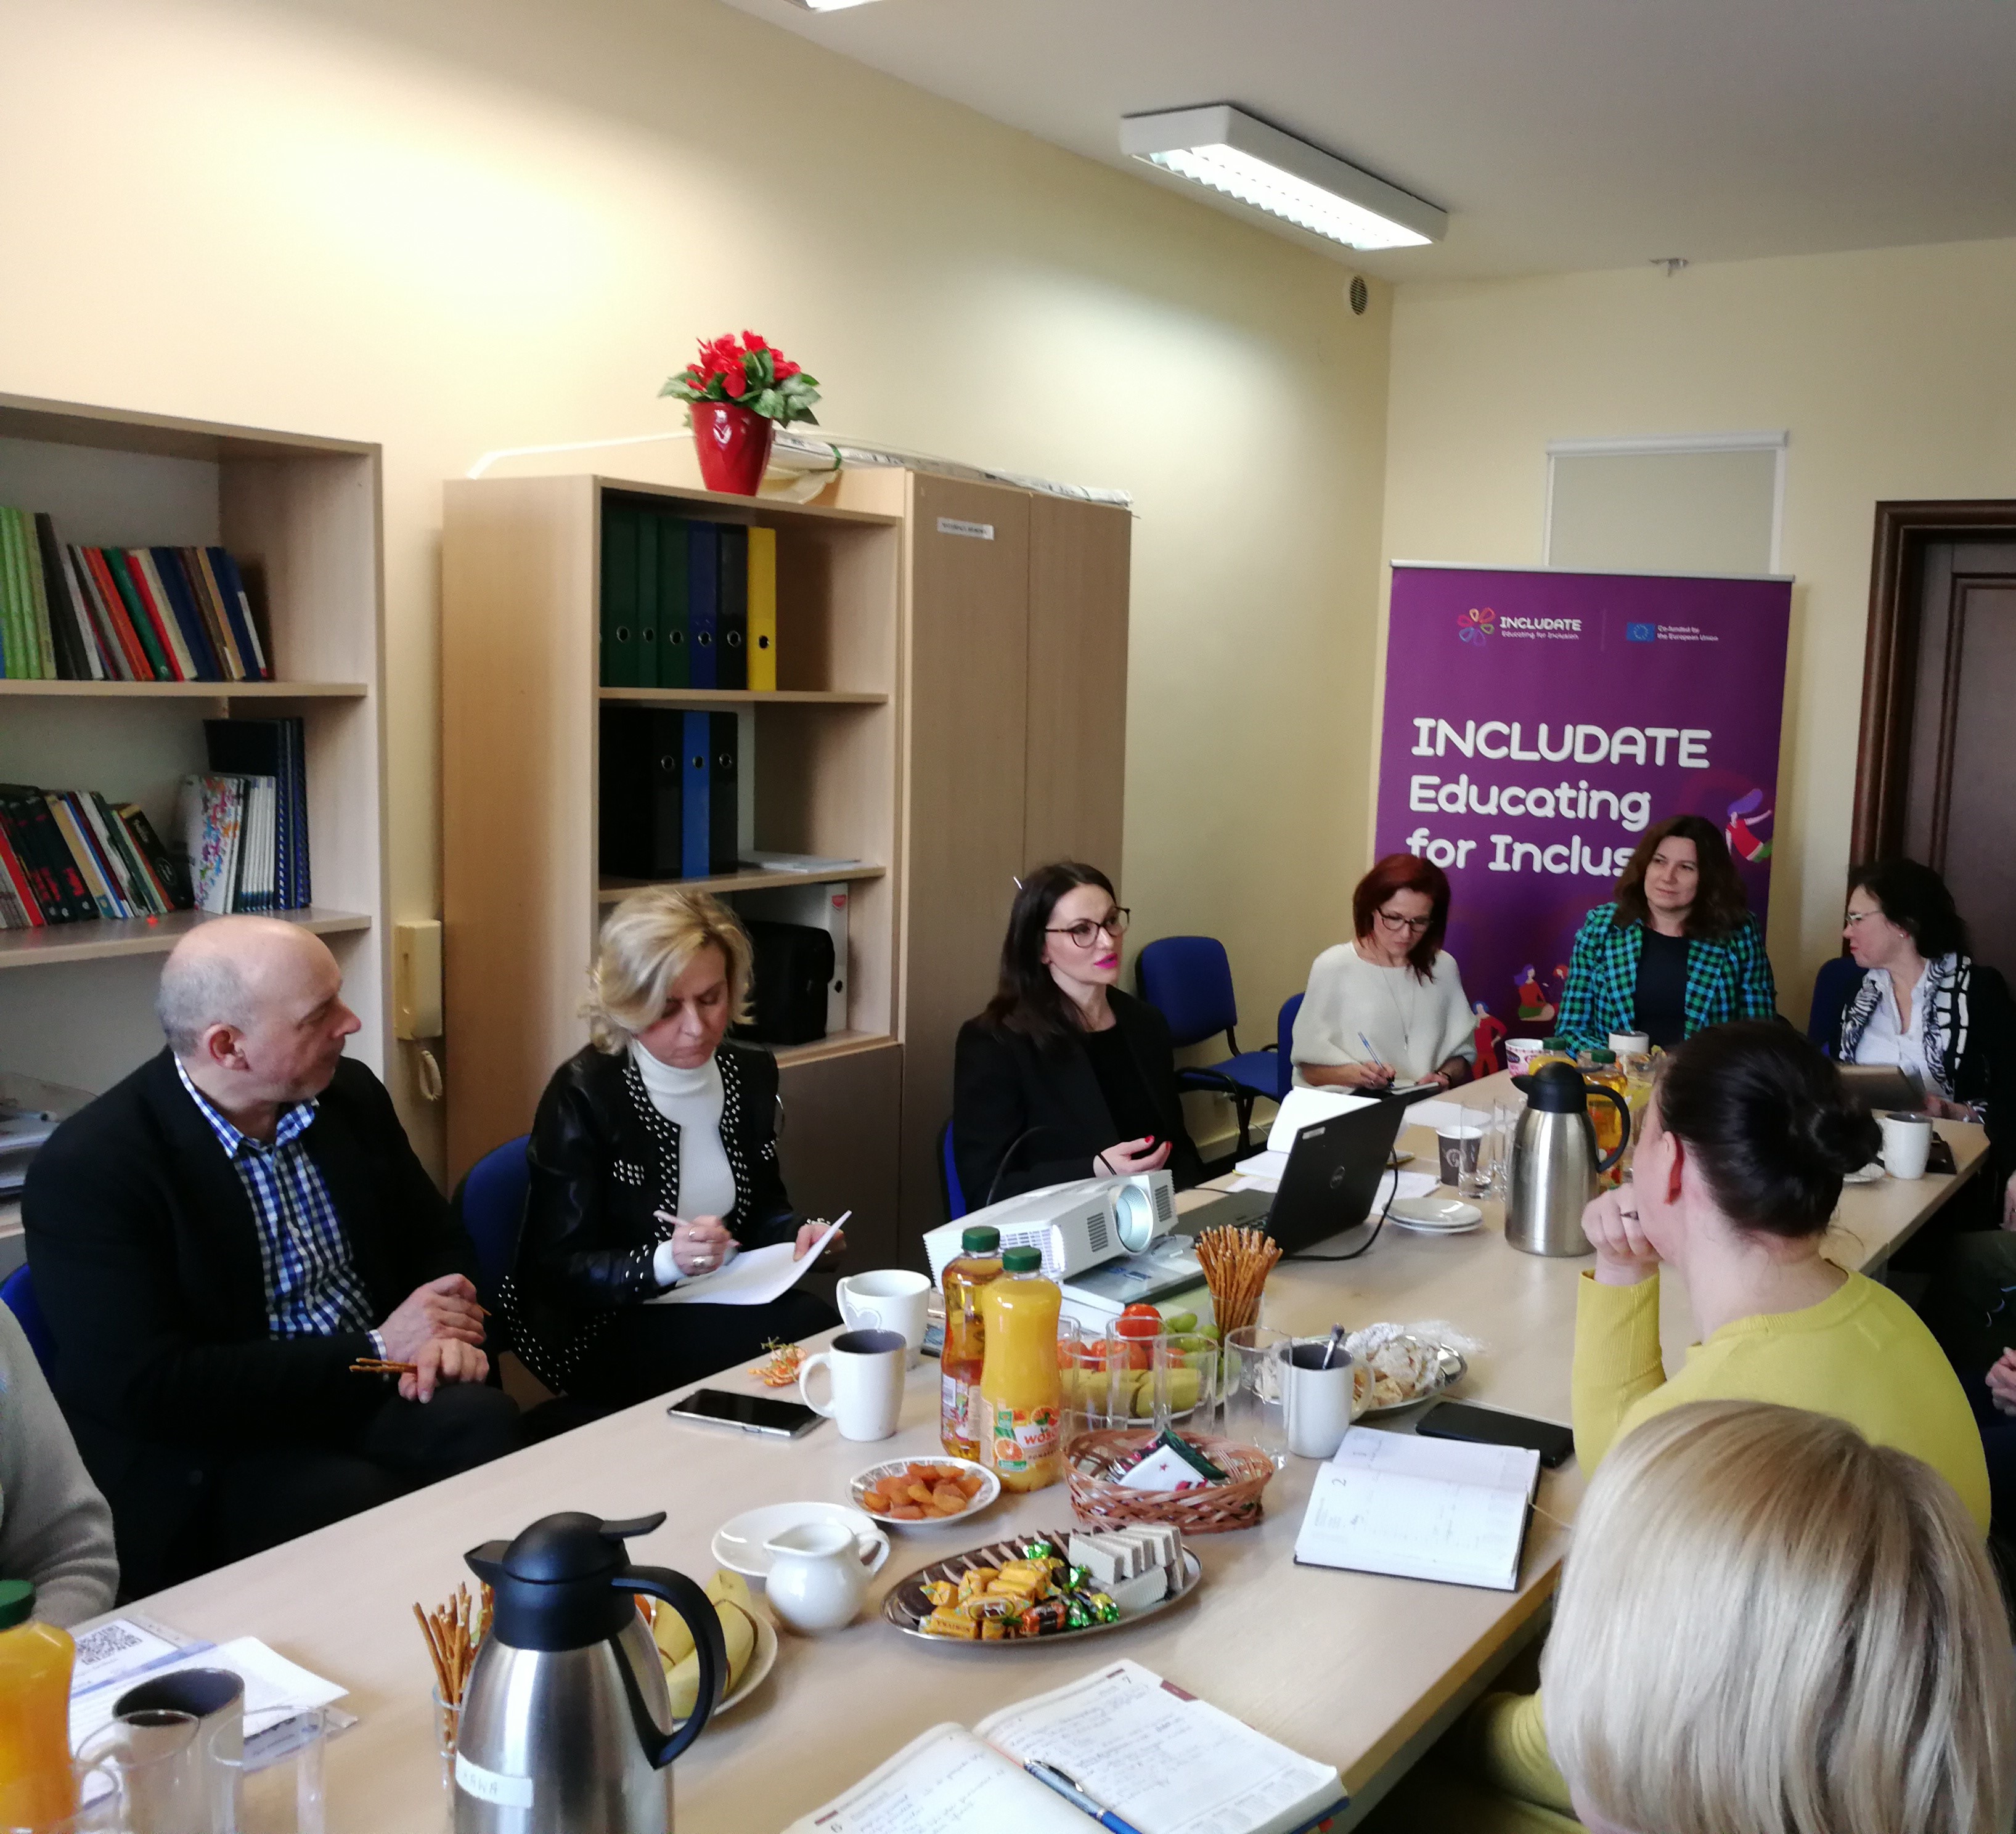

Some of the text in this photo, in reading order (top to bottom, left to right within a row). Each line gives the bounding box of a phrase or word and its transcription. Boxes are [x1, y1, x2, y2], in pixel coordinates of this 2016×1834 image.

[1500, 616, 1582, 631] INCLUDATE
[1501, 630, 1535, 639] Educating
[1668, 633, 1699, 641] European
[1411, 717, 1712, 769] INCLUDATE
[1409, 773, 1651, 832] Educating
[1406, 828, 1636, 877] for Inclus
